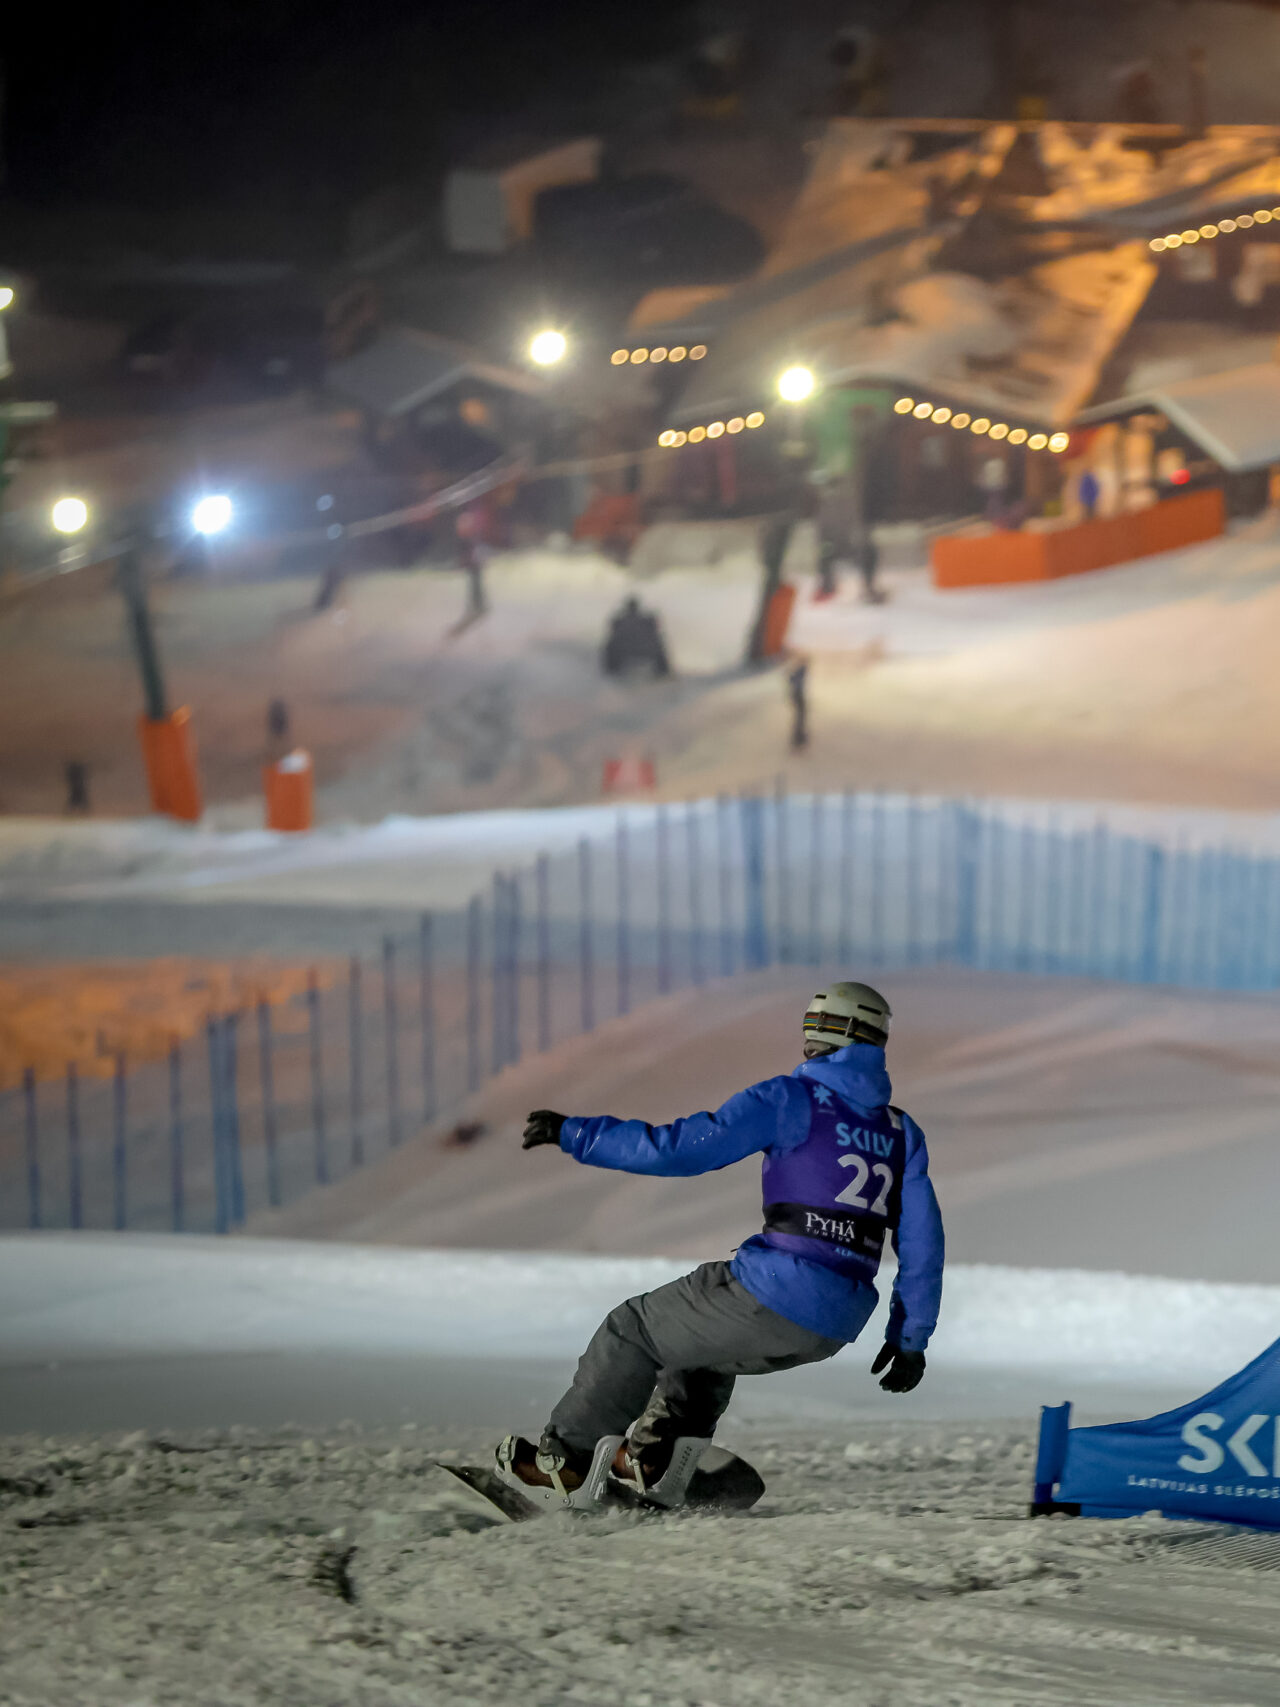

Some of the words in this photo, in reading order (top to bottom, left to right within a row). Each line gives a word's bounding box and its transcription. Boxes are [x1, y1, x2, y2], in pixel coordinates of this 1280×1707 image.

[835, 1122, 895, 1158] SKILV
[834, 1153, 894, 1217] 22
[805, 1212, 855, 1239] PYHÄ
[1127, 1474, 1209, 1494] LATVIJAS
